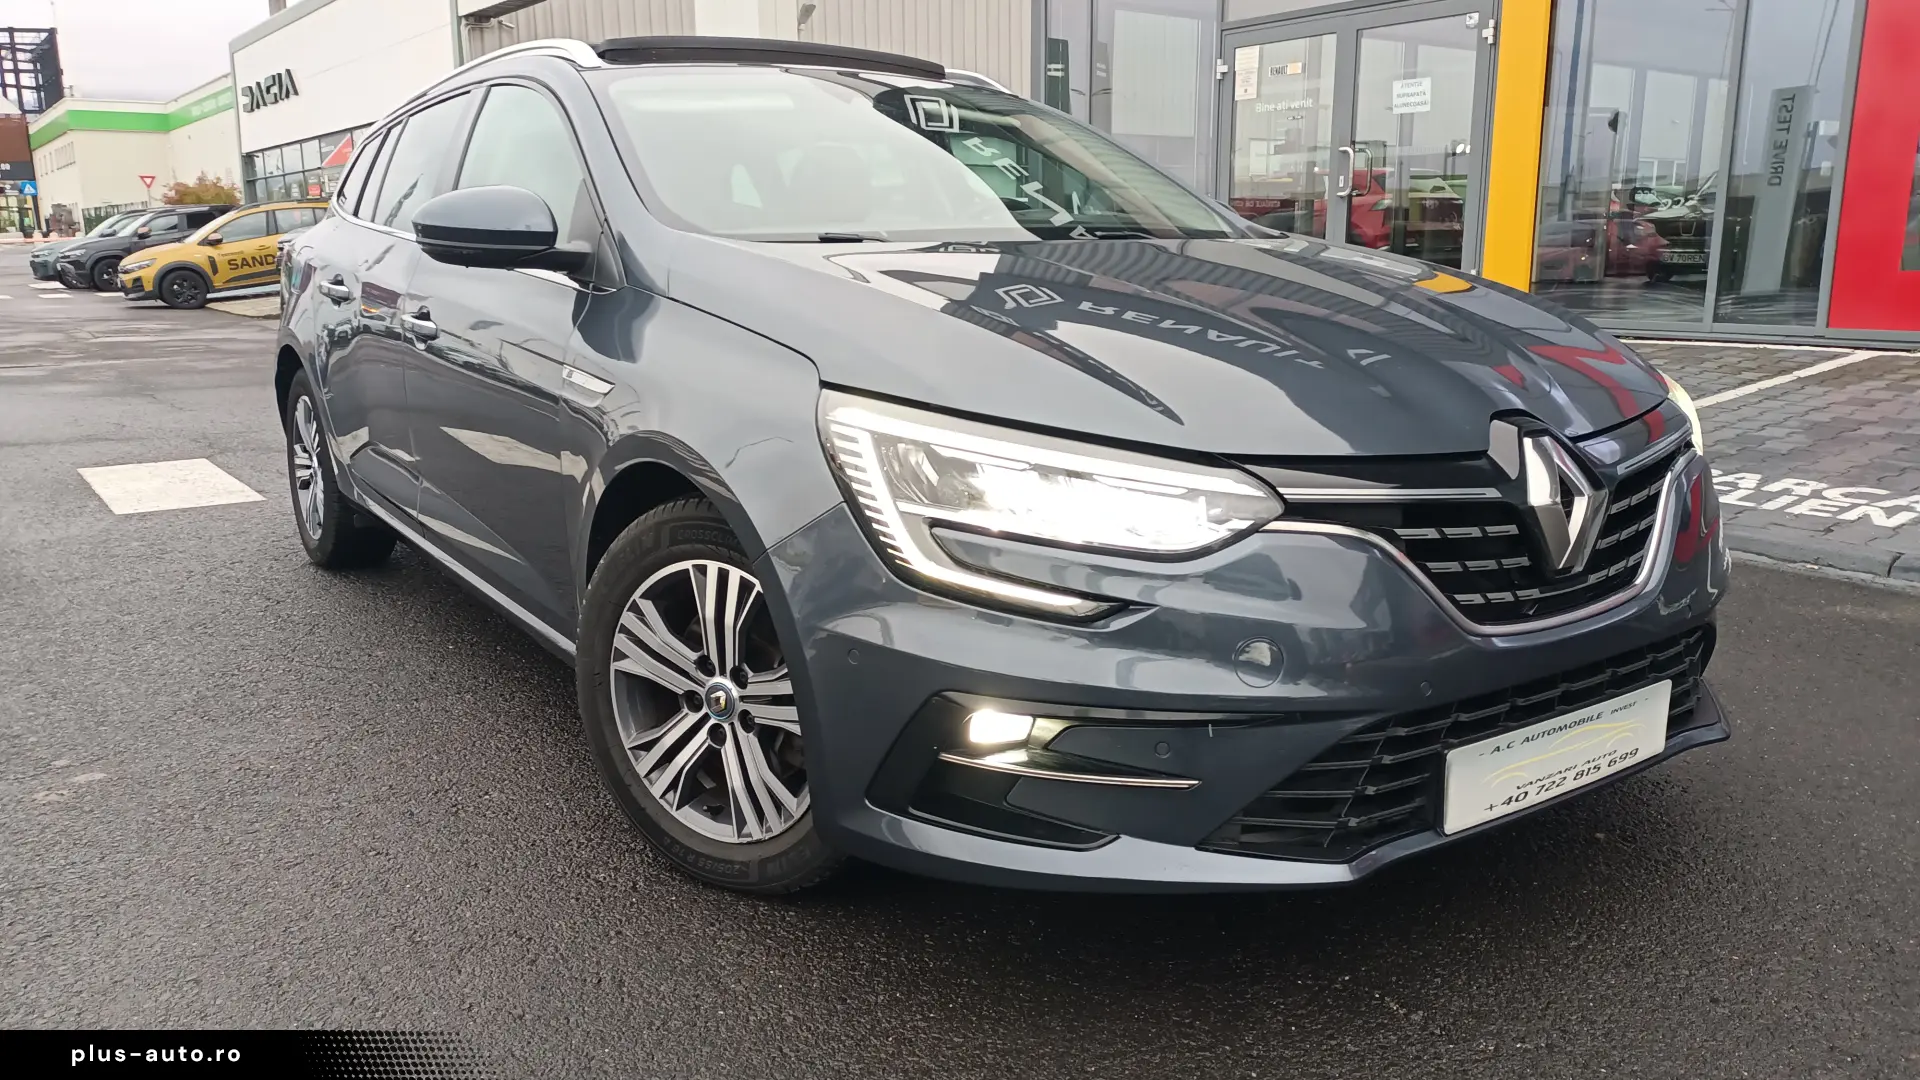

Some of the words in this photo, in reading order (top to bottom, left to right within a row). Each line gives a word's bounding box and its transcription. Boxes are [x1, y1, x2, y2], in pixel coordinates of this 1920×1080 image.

[1255, 102, 1275, 113] Bine
[1289, 97, 1313, 109] venit
[1490, 740, 1516, 755] A.C
[1520, 711, 1605, 746] AUTOMOBILE
[1609, 701, 1638, 716] INVEST
[1484, 791, 1530, 812] +40
[1535, 775, 1567, 797] 722
[1572, 762, 1602, 782] 815
[1606, 747, 1640, 769] 699
[1516, 764, 1578, 790] VANZARI
[1581, 749, 1618, 767] AUTO
